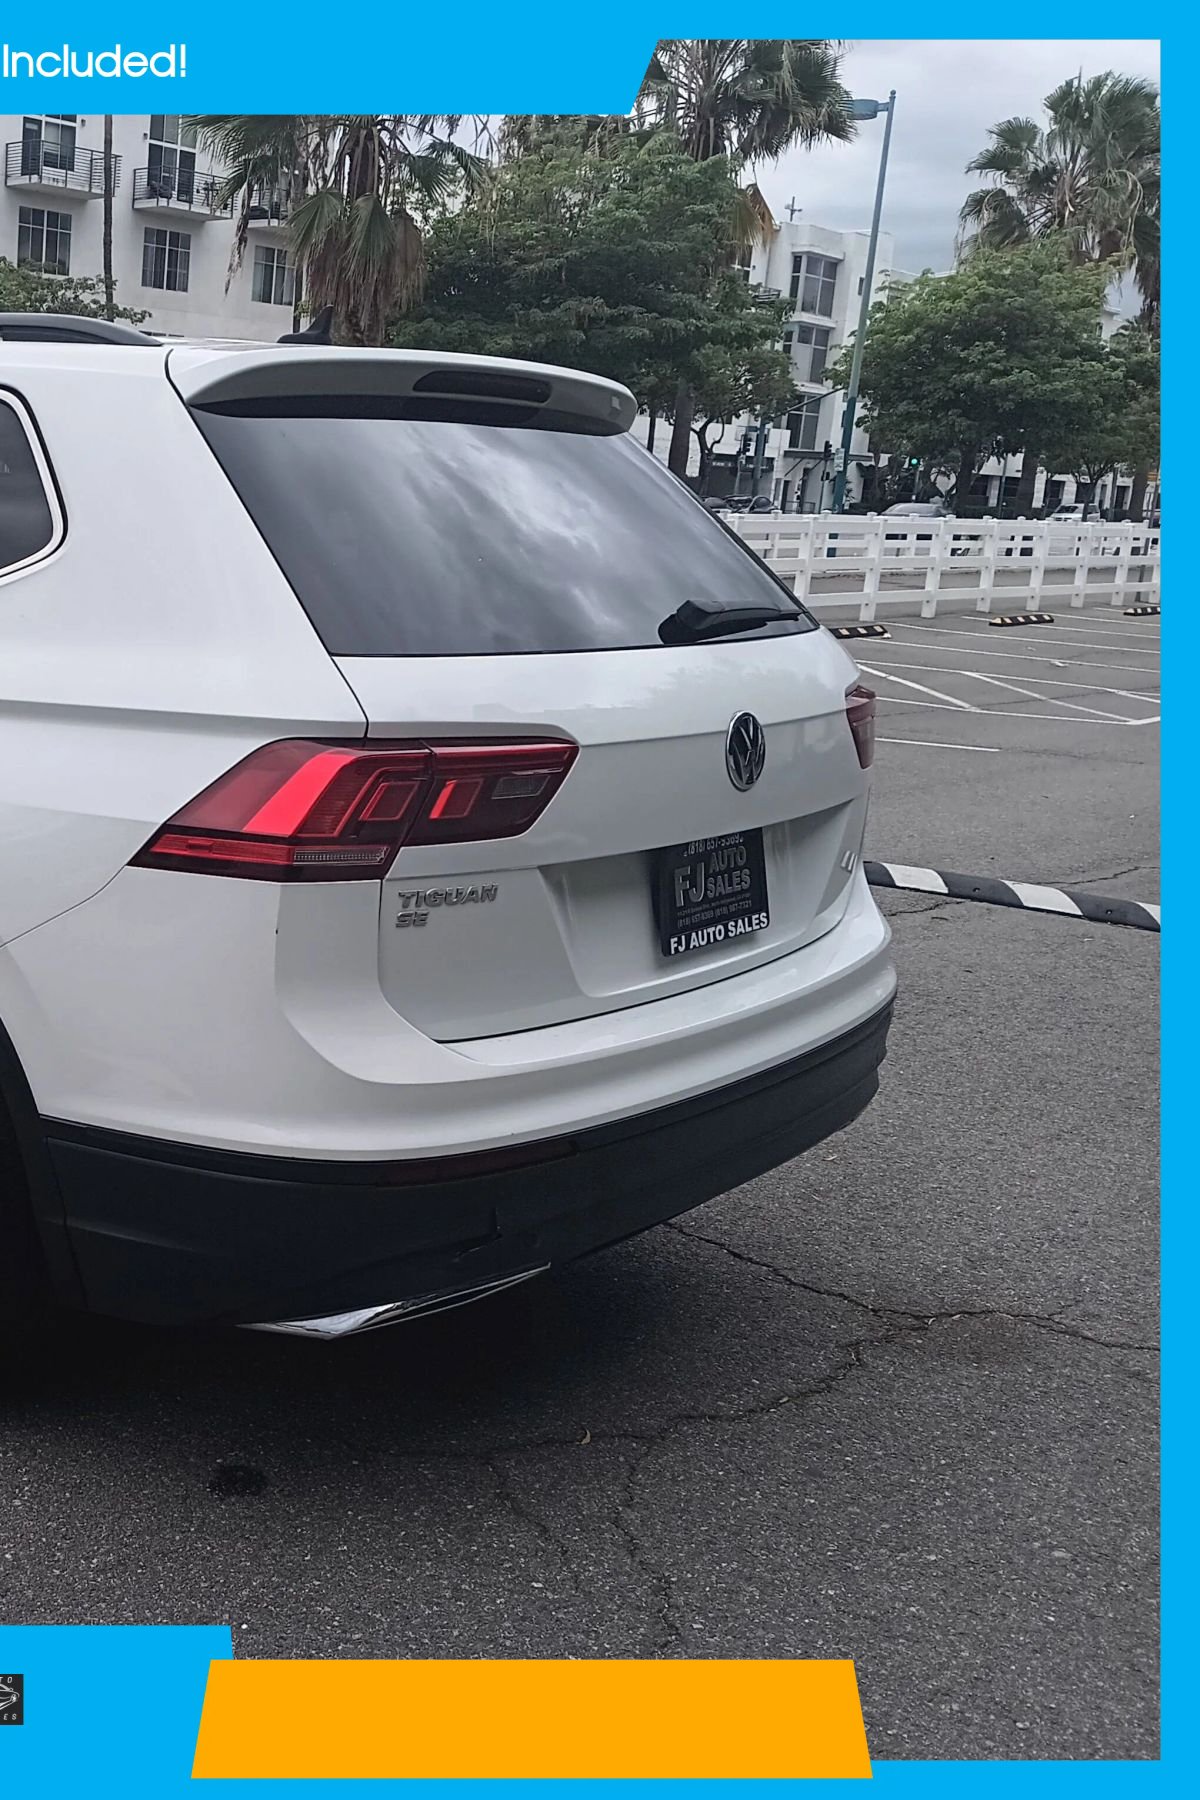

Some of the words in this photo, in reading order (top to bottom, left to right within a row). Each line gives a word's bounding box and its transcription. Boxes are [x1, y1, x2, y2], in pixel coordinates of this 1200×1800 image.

[674, 862, 705, 907] FJ
[709, 846, 747, 873] AUTO
[706, 868, 750, 898] SALES
[398, 883, 498, 908] TIGUAN
[395, 909, 429, 928] SE
[670, 935, 686, 955] FJ
[690, 924, 725, 949] AUTO
[728, 912, 768, 938] SALES
